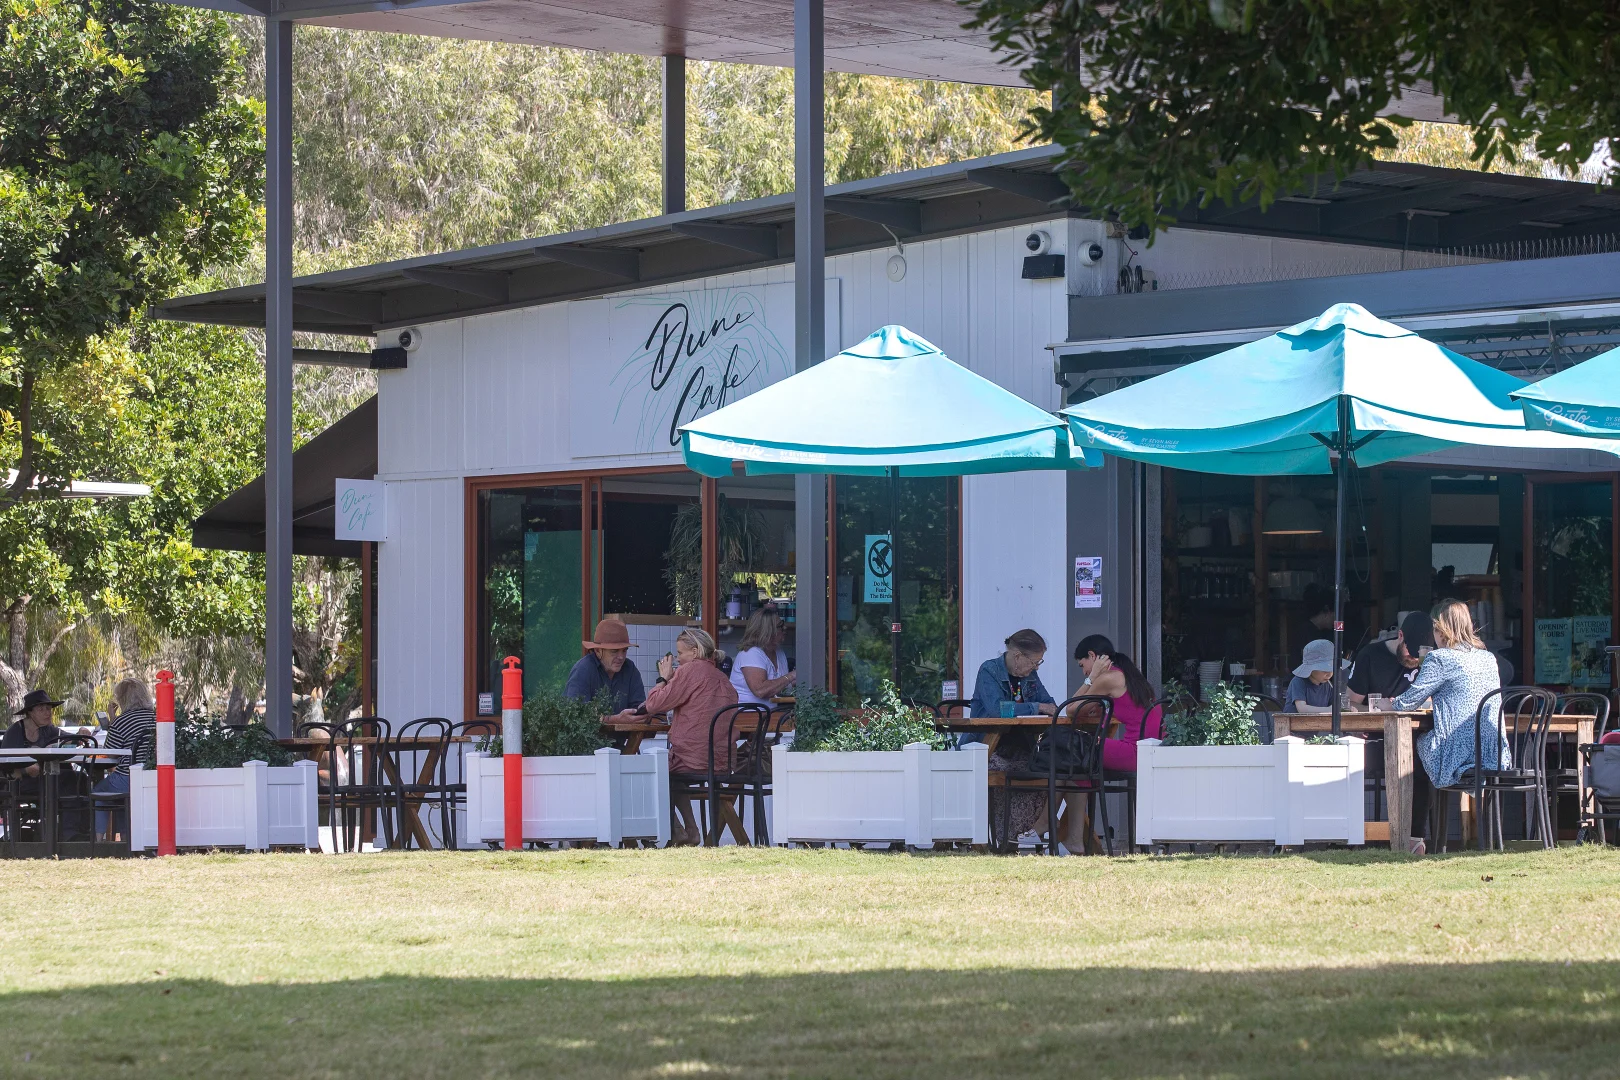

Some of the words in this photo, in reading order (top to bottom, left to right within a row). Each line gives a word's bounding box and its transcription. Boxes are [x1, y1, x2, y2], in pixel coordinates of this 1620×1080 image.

[645, 303, 755, 391] Dune
[670, 344, 761, 446] Cafe
[1544, 404, 1590, 426] Gusto
